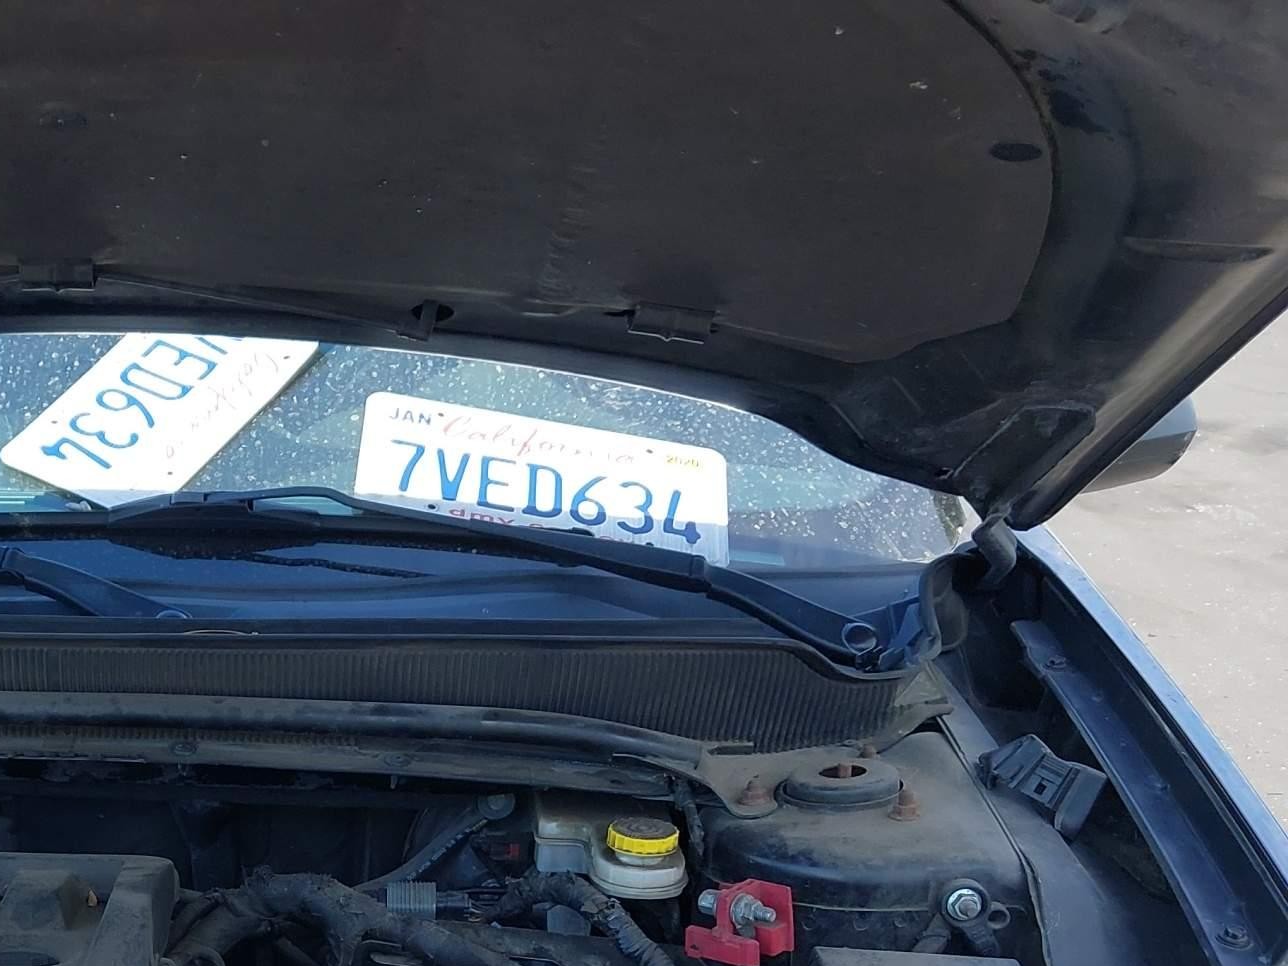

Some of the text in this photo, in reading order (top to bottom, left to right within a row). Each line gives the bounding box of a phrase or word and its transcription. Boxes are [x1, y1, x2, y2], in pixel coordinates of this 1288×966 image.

[39, 336, 228, 470] ED634
[388, 407, 433, 426] JAN
[390, 438, 703, 545] 7VED634
